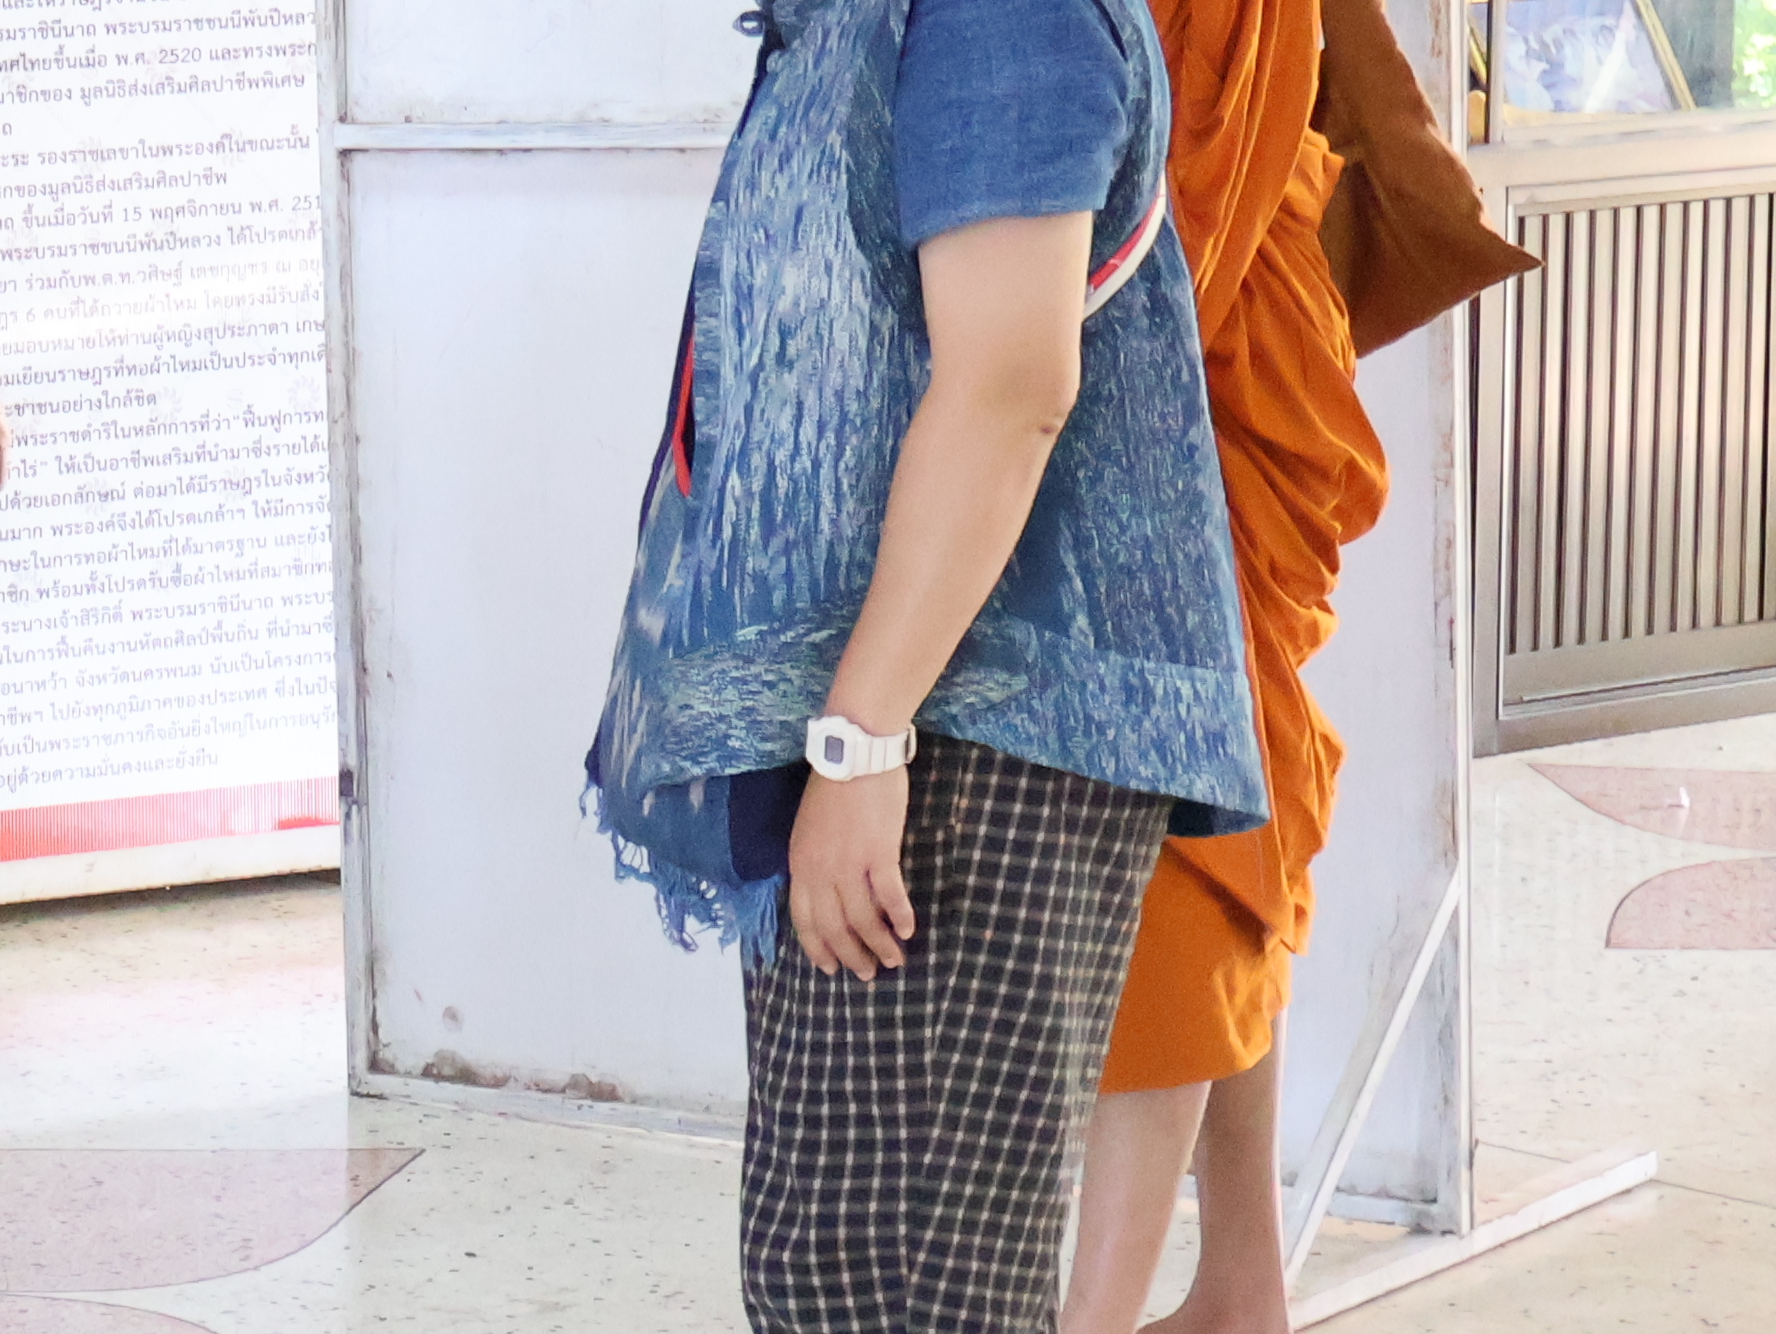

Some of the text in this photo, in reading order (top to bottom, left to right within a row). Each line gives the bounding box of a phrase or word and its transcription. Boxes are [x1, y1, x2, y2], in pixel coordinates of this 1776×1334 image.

[115, 50, 152, 67] พ.ศ.
[158, 47, 202, 65] 2520
[121, 205, 143, 222] 15
[149, 197, 243, 224] พฤศจิกายน
[248, 198, 284, 214] พ.ศ.
[26, 307, 36, 323] 6
[133, 464, 329, 500] ต่อมาได้มีราษฎรในจังหวั
[251, 495, 330, 519] ให้มีการจั
